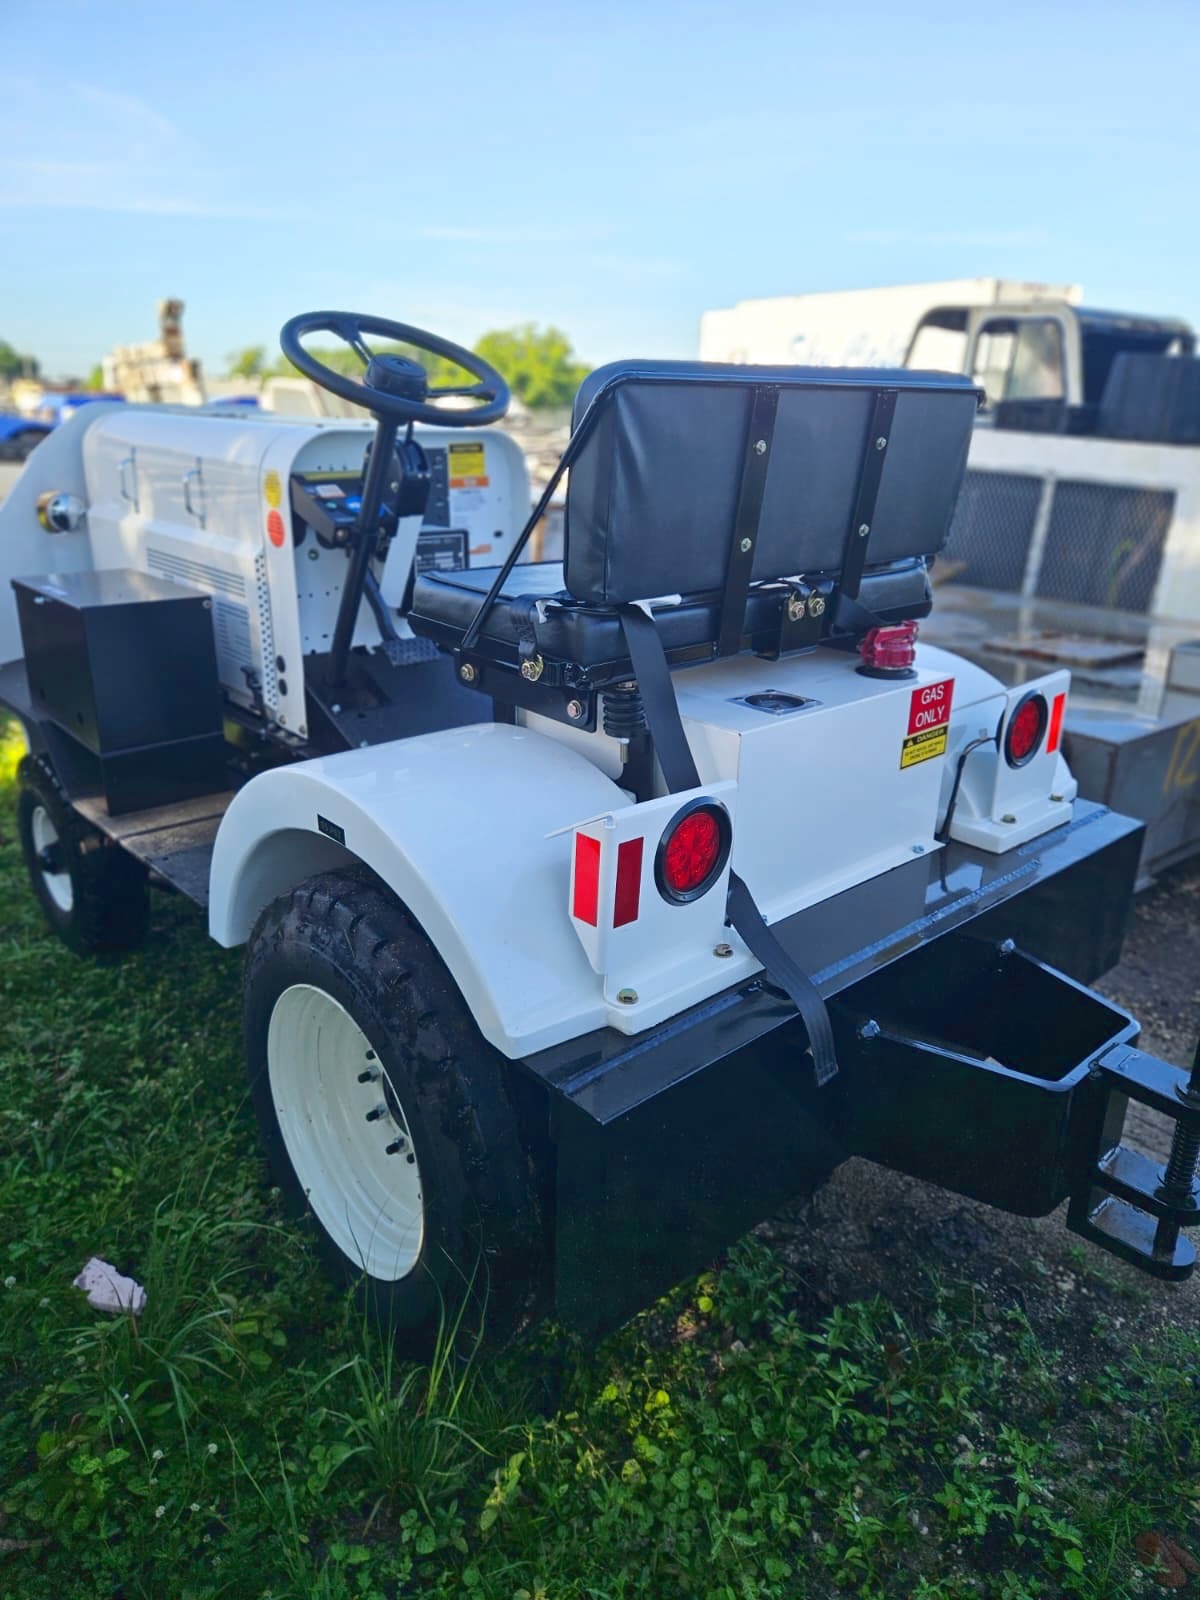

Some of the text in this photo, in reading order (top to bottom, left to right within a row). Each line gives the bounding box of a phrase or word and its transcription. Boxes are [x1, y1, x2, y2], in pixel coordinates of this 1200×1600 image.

[921, 684, 945, 705] GAS
[915, 705, 946, 728] ONLY
[916, 728, 946, 743] DANGER
